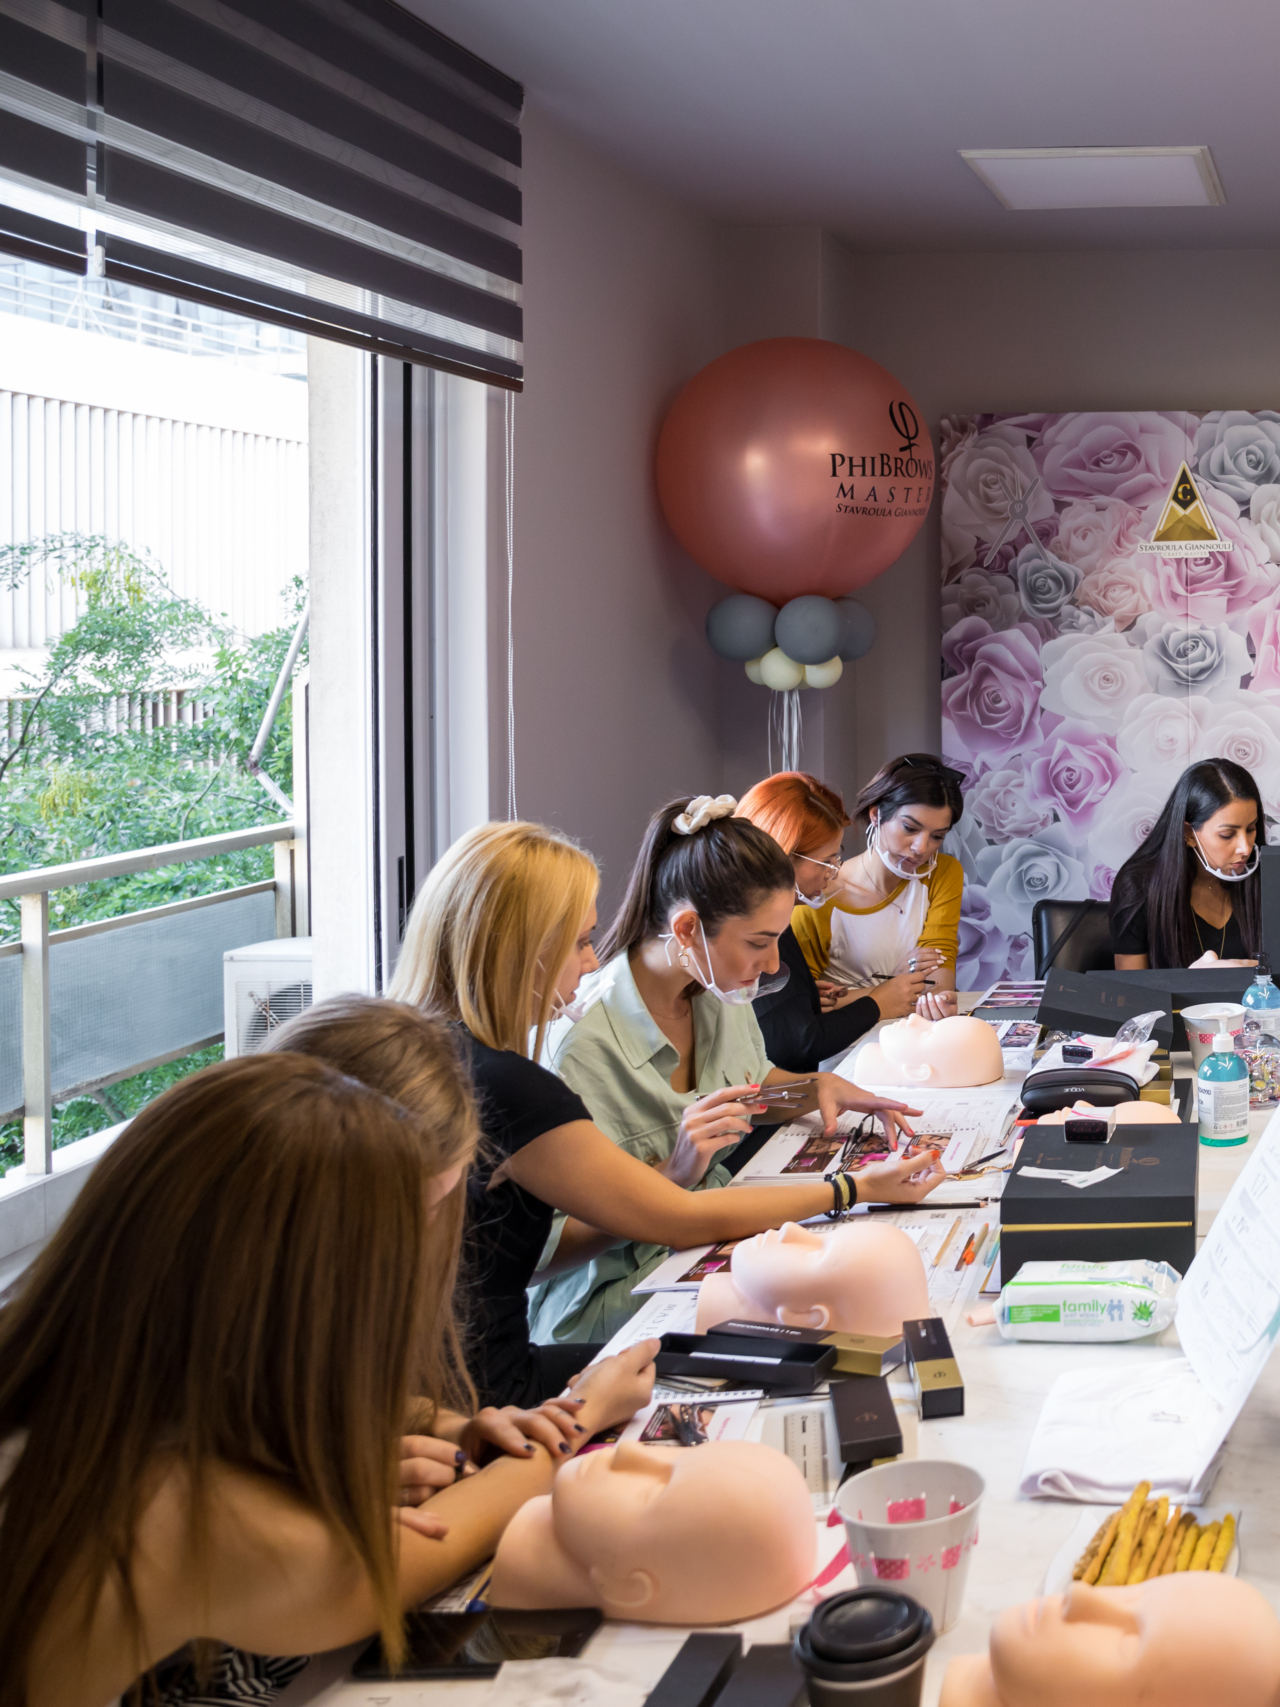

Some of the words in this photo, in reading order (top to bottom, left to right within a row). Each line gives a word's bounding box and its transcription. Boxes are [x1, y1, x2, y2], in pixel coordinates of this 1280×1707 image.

[828, 452, 934, 481] PHIBROWS
[1177, 483, 1191, 501] C
[836, 503, 893, 517] STAVROULA
[1139, 544, 1183, 552] STAVROULA
[1184, 543, 1232, 551] GIANNOULI
[1062, 1299, 1107, 1316] family
[1079, 1311, 1099, 1319] wipes
